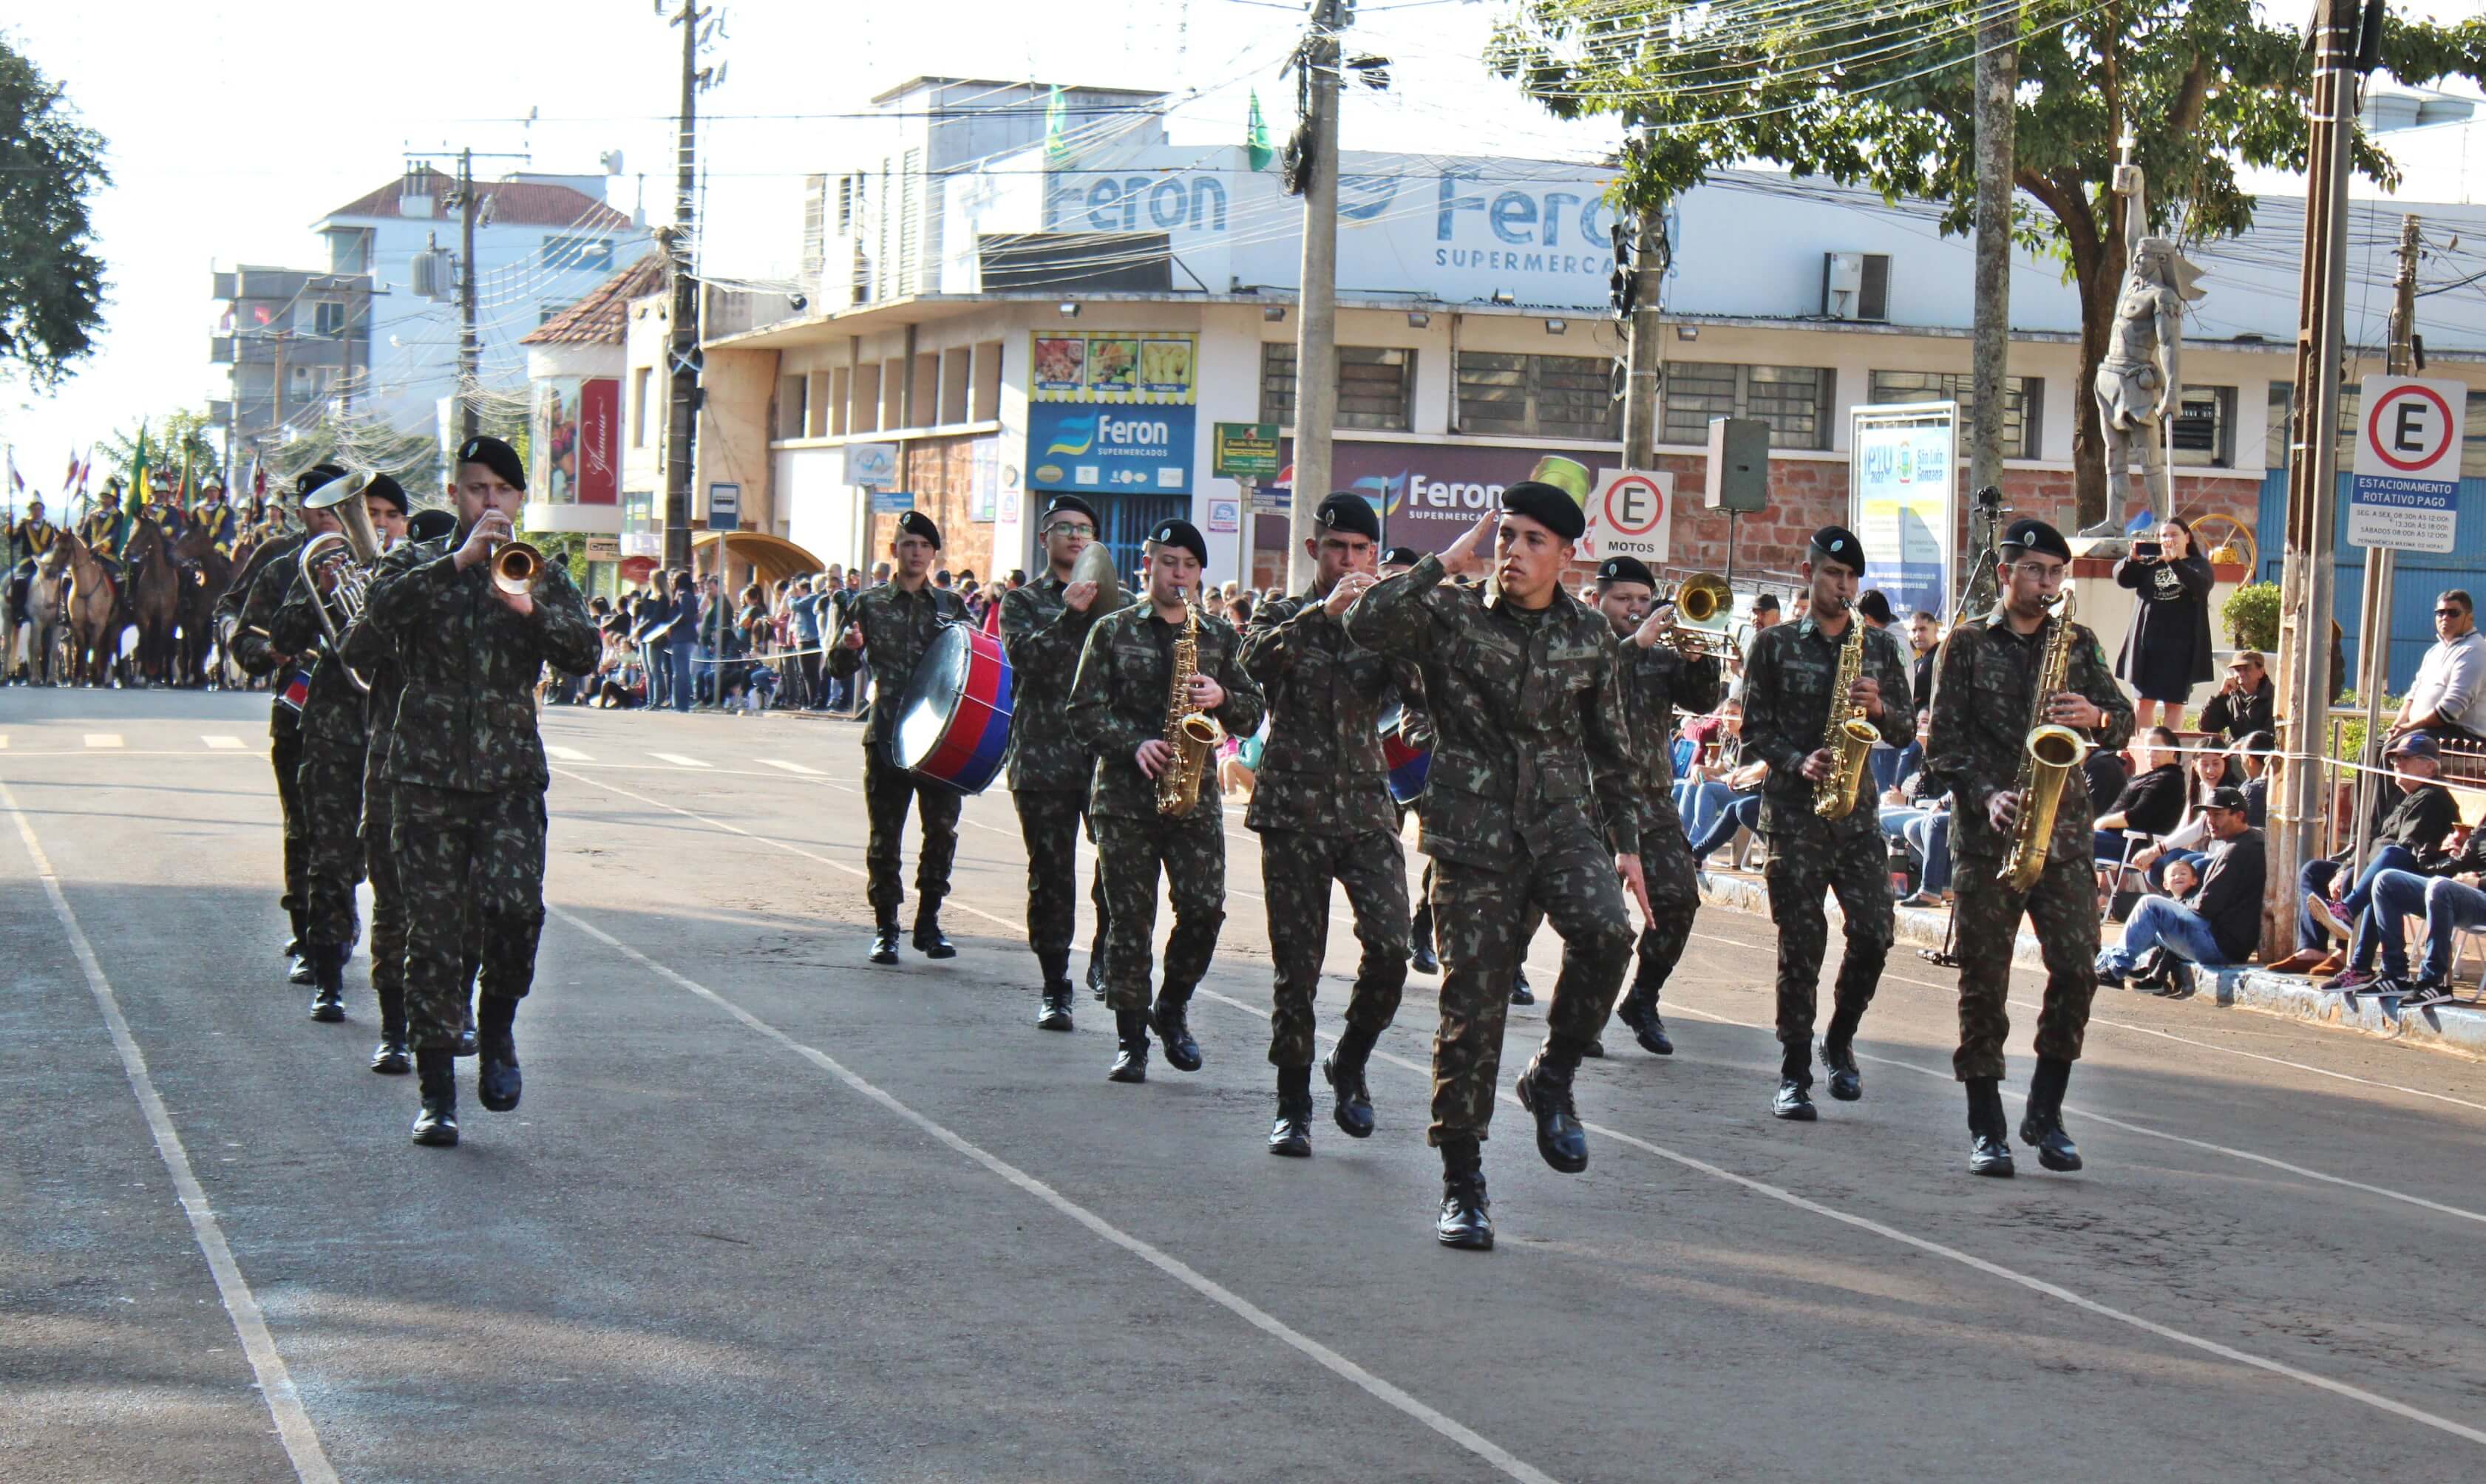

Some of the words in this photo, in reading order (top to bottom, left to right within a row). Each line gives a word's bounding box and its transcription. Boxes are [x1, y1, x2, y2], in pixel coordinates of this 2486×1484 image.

[1046, 169, 1227, 231] Feron
[1437, 164, 1680, 253] Fero
[1436, 248, 1679, 279] SUPERMERCAS
[1098, 415, 1169, 444] Feron
[2394, 402, 2428, 452] E
[1098, 447, 1168, 457] SUPERMERCADOS
[1410, 474, 1505, 509] Feron
[2359, 477, 2452, 494] ESTACIONAMENTO
[2363, 491, 2414, 505] ROTATIVO
[2417, 496, 2445, 507] PAGO
[1409, 511, 1503, 523] SUPERMERCAO
[1623, 487, 1646, 523] E
[1609, 541, 1655, 553] MOTOS
